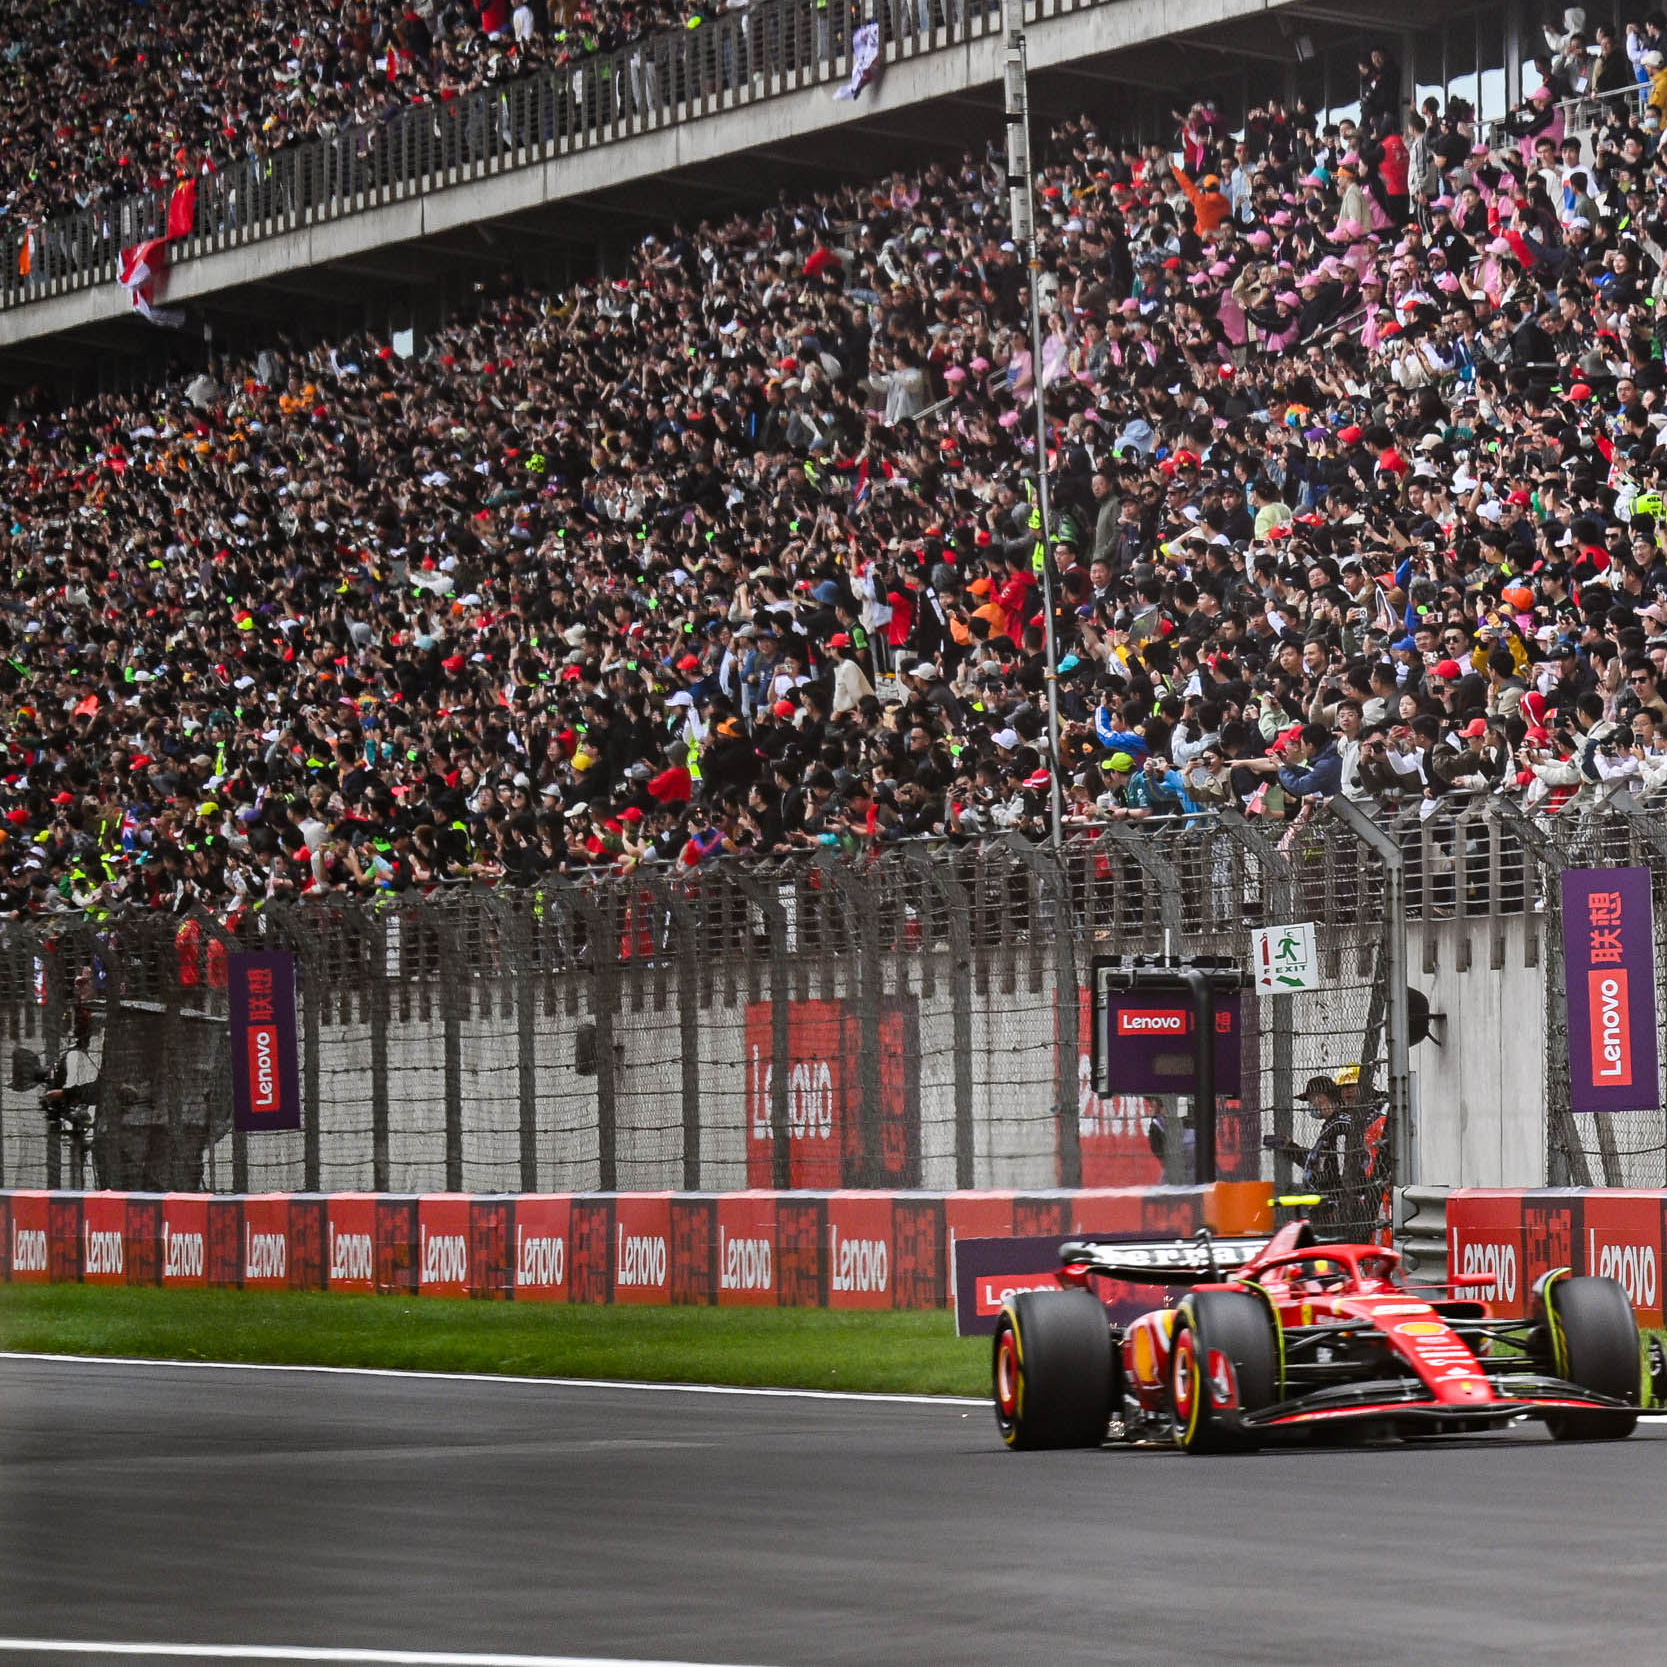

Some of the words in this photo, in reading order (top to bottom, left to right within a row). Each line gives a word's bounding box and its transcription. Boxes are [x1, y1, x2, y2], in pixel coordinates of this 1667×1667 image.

[1588, 892, 1624, 964] 联想
[1275, 965, 1308, 974] EXIT
[1123, 1015, 1181, 1029] Lenovo
[1600, 978, 1622, 1077] Lenovo
[256, 1032, 273, 1105] Lenovo
[753, 1044, 833, 1140] Lovo
[12, 1218, 47, 1271] Lenovo
[85, 1220, 123, 1275] Lenovo
[162, 1222, 204, 1277] Lenovo
[246, 1222, 286, 1278] Lenovo
[330, 1222, 373, 1280] Lenovo
[421, 1224, 467, 1284] Lenovo
[517, 1224, 564, 1286] Lenovo
[618, 1223, 667, 1287] Lenovo
[720, 1225, 771, 1290] Lenovo
[832, 1224, 888, 1292] Lenovo
[1452, 1226, 1516, 1303] Lenovo
